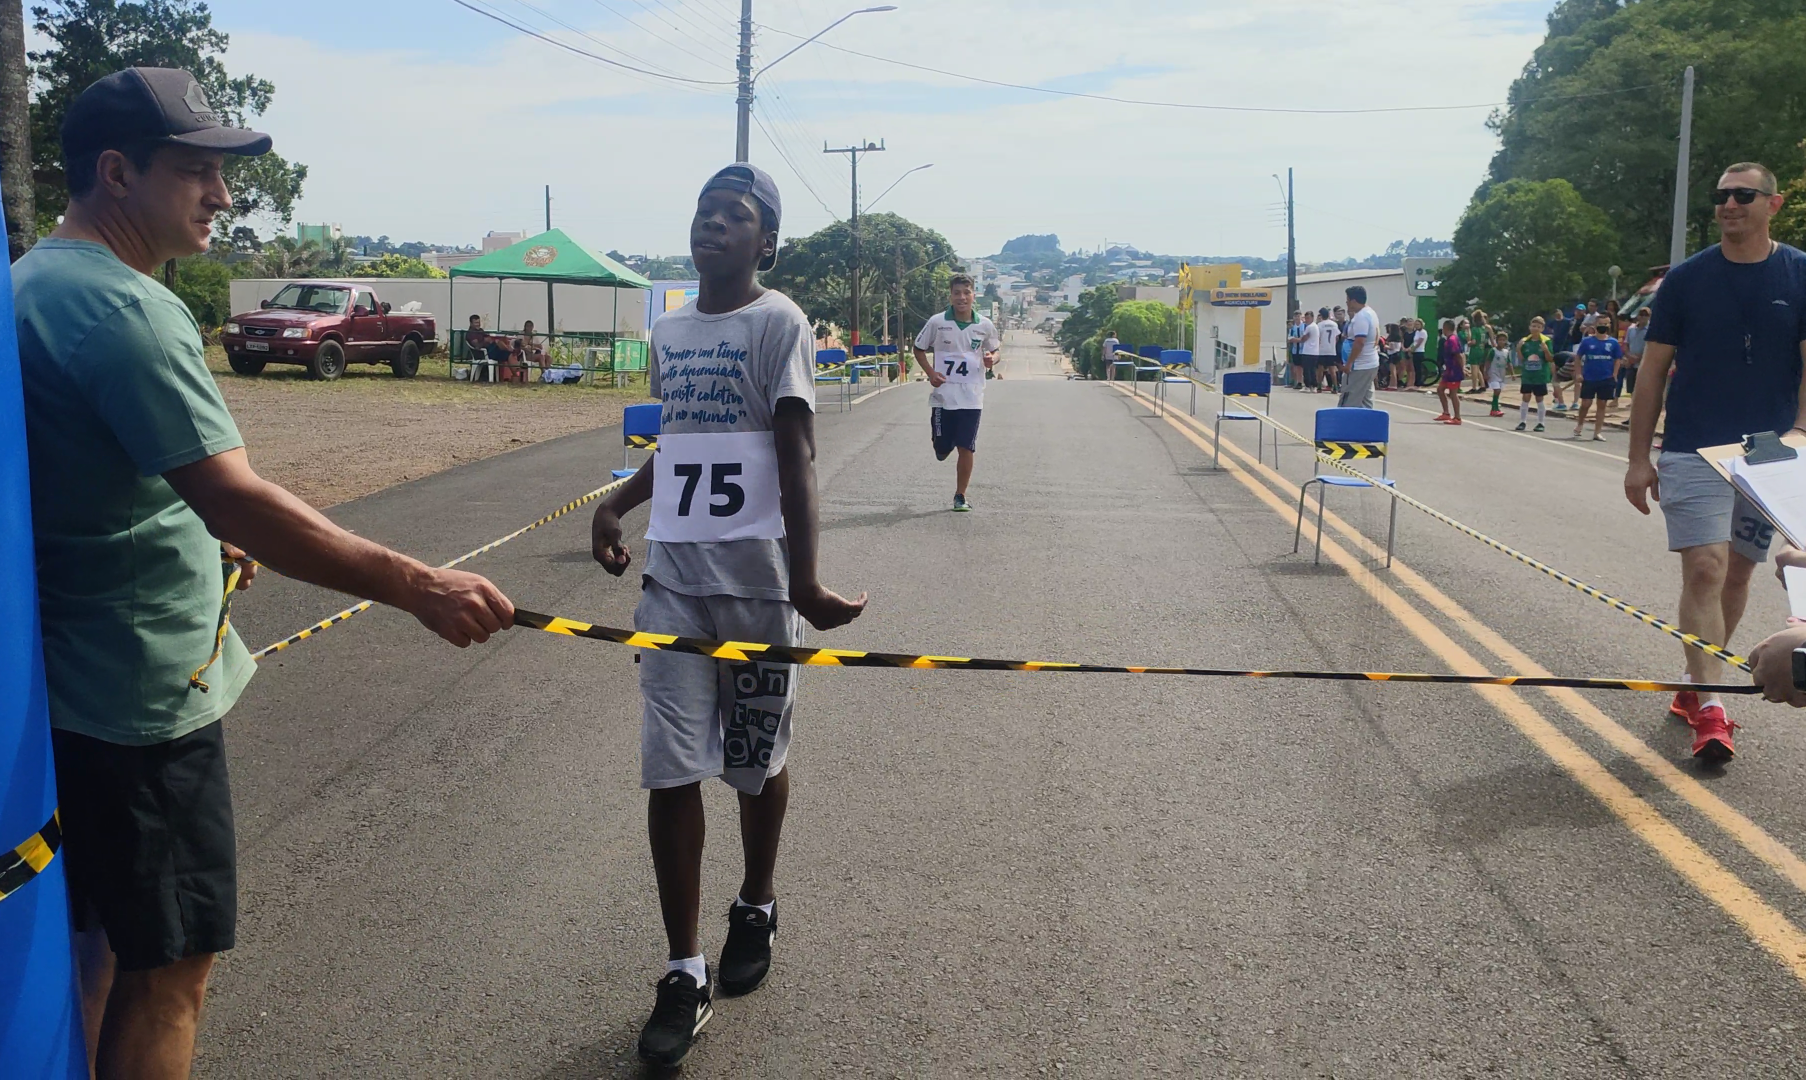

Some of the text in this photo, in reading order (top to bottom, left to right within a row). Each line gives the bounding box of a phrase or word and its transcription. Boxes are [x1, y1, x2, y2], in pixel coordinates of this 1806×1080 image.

[1326, 329, 1333, 344] 7
[717, 340, 748, 361] time
[943, 360, 969, 377] 74
[670, 380, 697, 403] existe
[697, 380, 744, 405] coletivo
[675, 409, 688, 421] no
[673, 463, 746, 518] 75
[1735, 516, 1774, 550] 35
[735, 672, 786, 694] on
[734, 704, 778, 731] the
[725, 737, 772, 766] go
